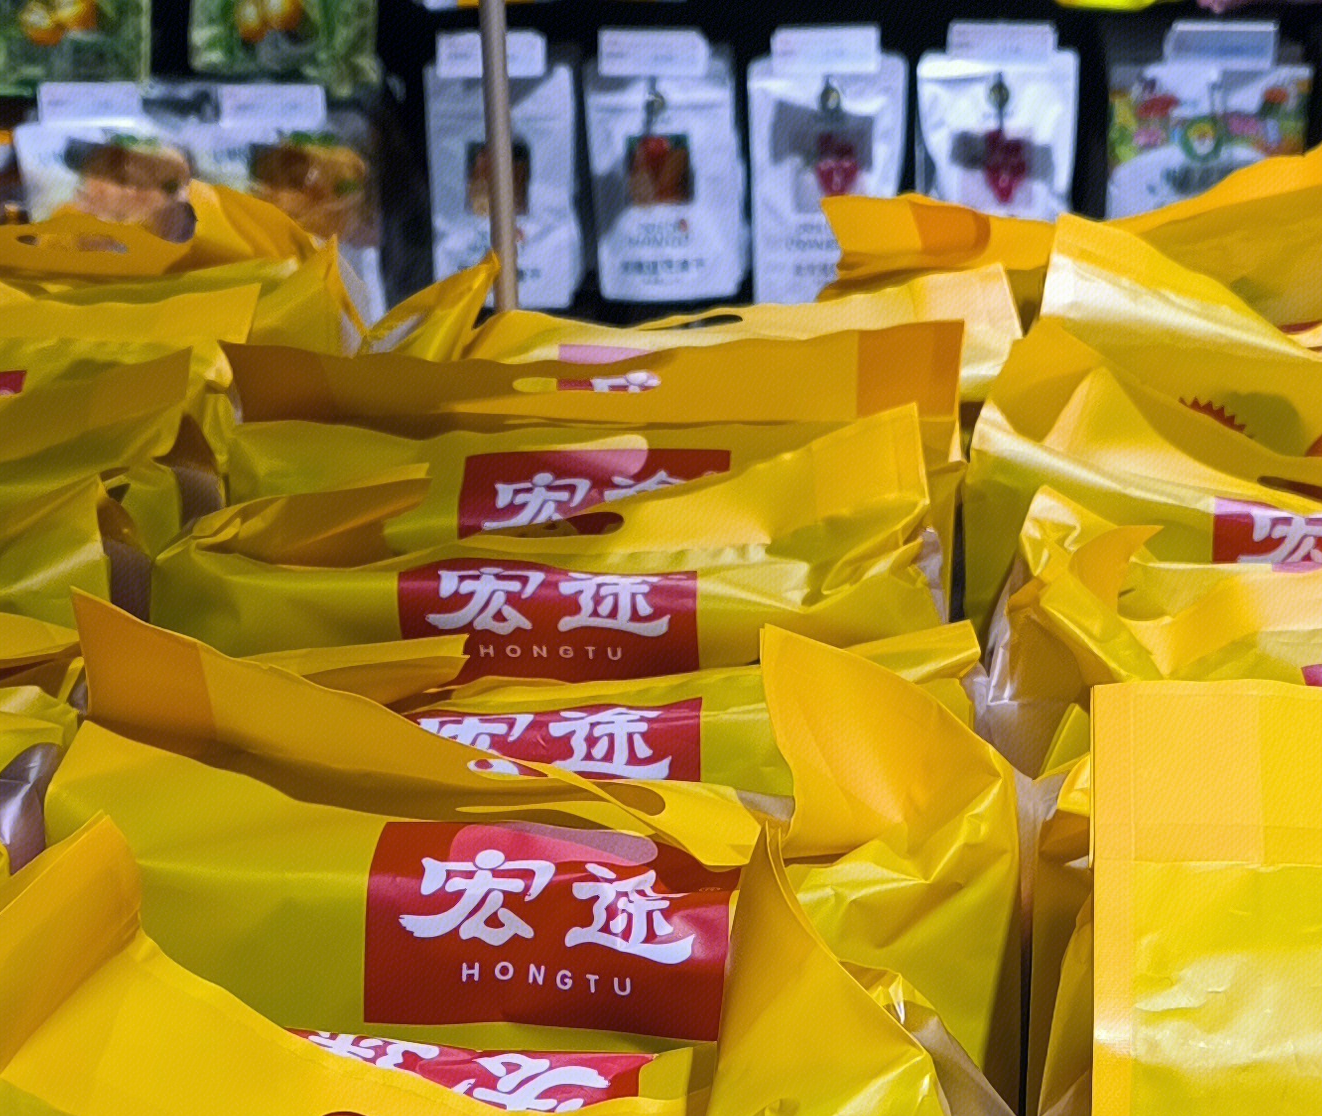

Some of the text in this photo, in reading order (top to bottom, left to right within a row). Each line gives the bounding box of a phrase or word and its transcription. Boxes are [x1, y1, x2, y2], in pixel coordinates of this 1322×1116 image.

[425, 566, 670, 635] 宏途
[478, 644, 623, 662] HONGTU
[398, 849, 695, 965] 宏途
[461, 961, 633, 996] HONGTU
